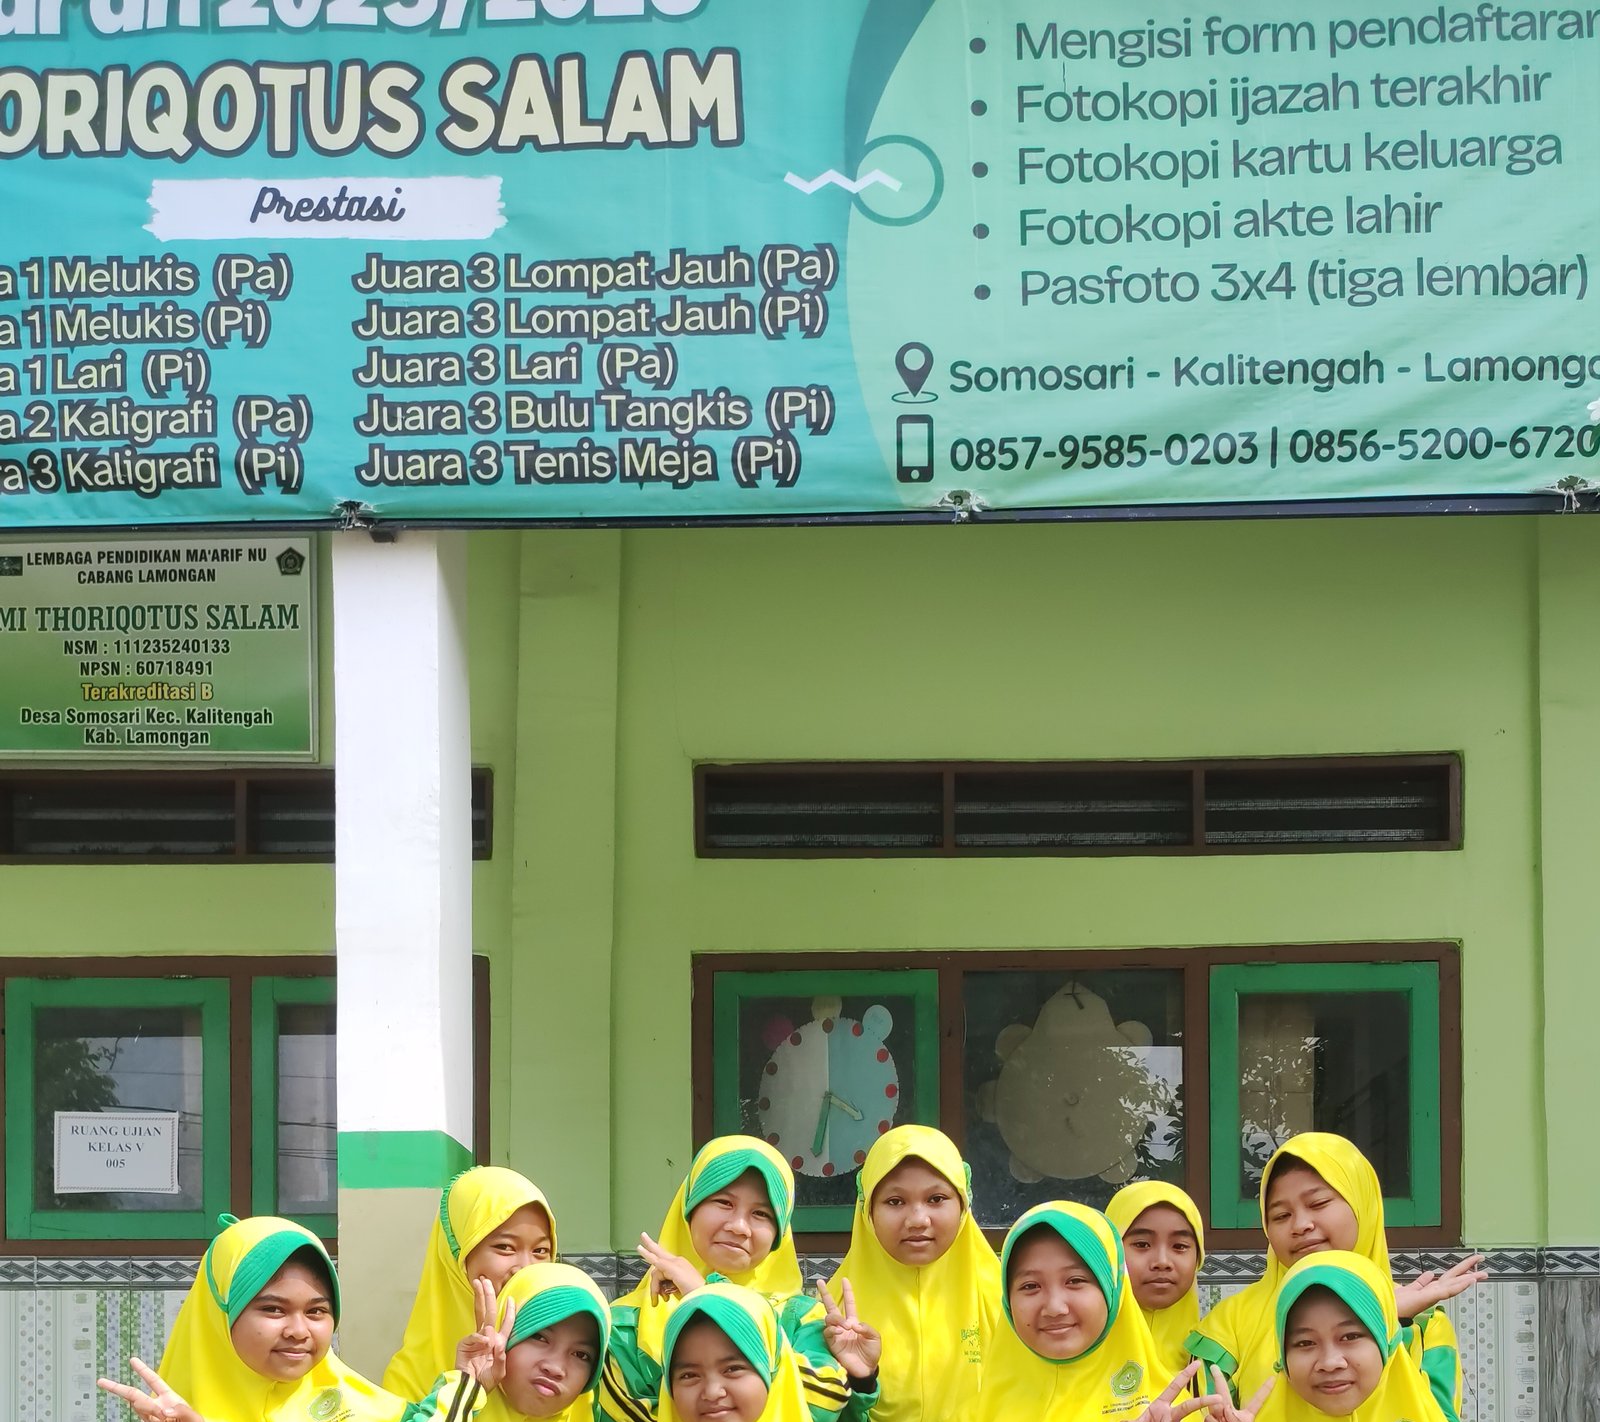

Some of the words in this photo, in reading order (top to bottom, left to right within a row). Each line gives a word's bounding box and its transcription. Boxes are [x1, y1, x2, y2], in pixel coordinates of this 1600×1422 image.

[1015, 17, 1192, 68] Mengisi
[1203, 16, 1316, 55] form
[442, 53, 739, 150] SALAM
[1017, 79, 1217, 127] Fotokopi
[1230, 72, 1359, 125] ijazah
[1370, 64, 1552, 109] terakhir
[1018, 140, 1219, 188] Fotokopi
[1232, 138, 1351, 178] kartu
[1364, 130, 1563, 175] keluarga
[249, 185, 407, 224] Prestasi
[1019, 201, 1221, 248] Fotokopi
[1233, 199, 1334, 238] akte
[1346, 192, 1443, 234] lahir
[25, 262, 39, 294] 1
[54, 258, 195, 293] Melukis
[217, 257, 290, 296] (Pa)
[357, 257, 460, 289] Juara
[472, 256, 495, 288] 3
[509, 256, 649, 294] Lompat
[660, 251, 750, 286] Jauh
[763, 248, 834, 288] (Pa)
[1021, 265, 1200, 306] Pasfoto
[1211, 262, 1296, 302] 3x4
[1307, 258, 1404, 307] (tiga
[1416, 254, 1588, 301] lembar)
[27, 310, 41, 343] 1
[55, 305, 195, 341] Melukis
[206, 304, 266, 345] (Pi)
[357, 304, 460, 336] Juara
[472, 302, 495, 334] 3
[509, 302, 650, 340] Lompat
[661, 298, 750, 332] Jauh
[764, 293, 824, 335] (Pi)
[28, 359, 42, 390] 1
[56, 354, 122, 390] Lari
[146, 352, 207, 395] (Pi)
[358, 351, 460, 383] Juara
[473, 348, 496, 380] 3
[510, 346, 578, 380] Lari
[602, 347, 674, 385] (Pa)
[950, 356, 1134, 393] Somosari
[1174, 350, 1385, 393] Kalitengah
[28, 405, 52, 438] 2
[63, 399, 213, 443] Kaligrafi
[236, 399, 305, 440] (Pa)
[358, 398, 461, 432] Juara
[474, 396, 497, 430] 3
[511, 395, 589, 429] Bulu
[600, 391, 748, 435] Tangkis
[770, 388, 831, 431] (Pi)
[35, 456, 57, 489] 3
[66, 446, 216, 494] Kaligrafi
[239, 447, 300, 489] (Pi)
[360, 447, 463, 481] Juara
[475, 445, 498, 480] 3
[509, 441, 611, 479] Tenis
[624, 440, 713, 484] Meja
[736, 438, 797, 483] (Pi)
[950, 430, 1259, 472] 0857-9585-0203
[26, 551, 93, 566] LEMBAGA
[97, 549, 181, 565] PENDIDIKAN
[186, 548, 243, 563] MA'ARIF
[248, 548, 267, 562] NU
[77, 570, 133, 584] CABANG
[138, 568, 216, 583] LAMONGAN
[34, 604, 199, 634] THORIQOTUS
[206, 604, 299, 631] SALAM
[64, 640, 98, 655] NSM
[114, 639, 230, 654] 111235240133
[80, 661, 120, 676] NPSN
[136, 661, 213, 675] 60718491
[81, 682, 196, 701] Terakreditasi
[201, 683, 214, 700] B
[21, 708, 61, 723] Desa
[66, 708, 140, 723] Somosari
[146, 708, 181, 723] Kec.
[186, 708, 273, 727] Kalitengah
[85, 729, 120, 743] Kab.
[127, 728, 210, 746] Lamongan
[71, 1125, 118, 1136] RUANG
[122, 1126, 162, 1137] UJIAN
[88, 1142, 132, 1152] KELAS
[135, 1142, 145, 1152] V
[106, 1159, 126, 1168] 005
